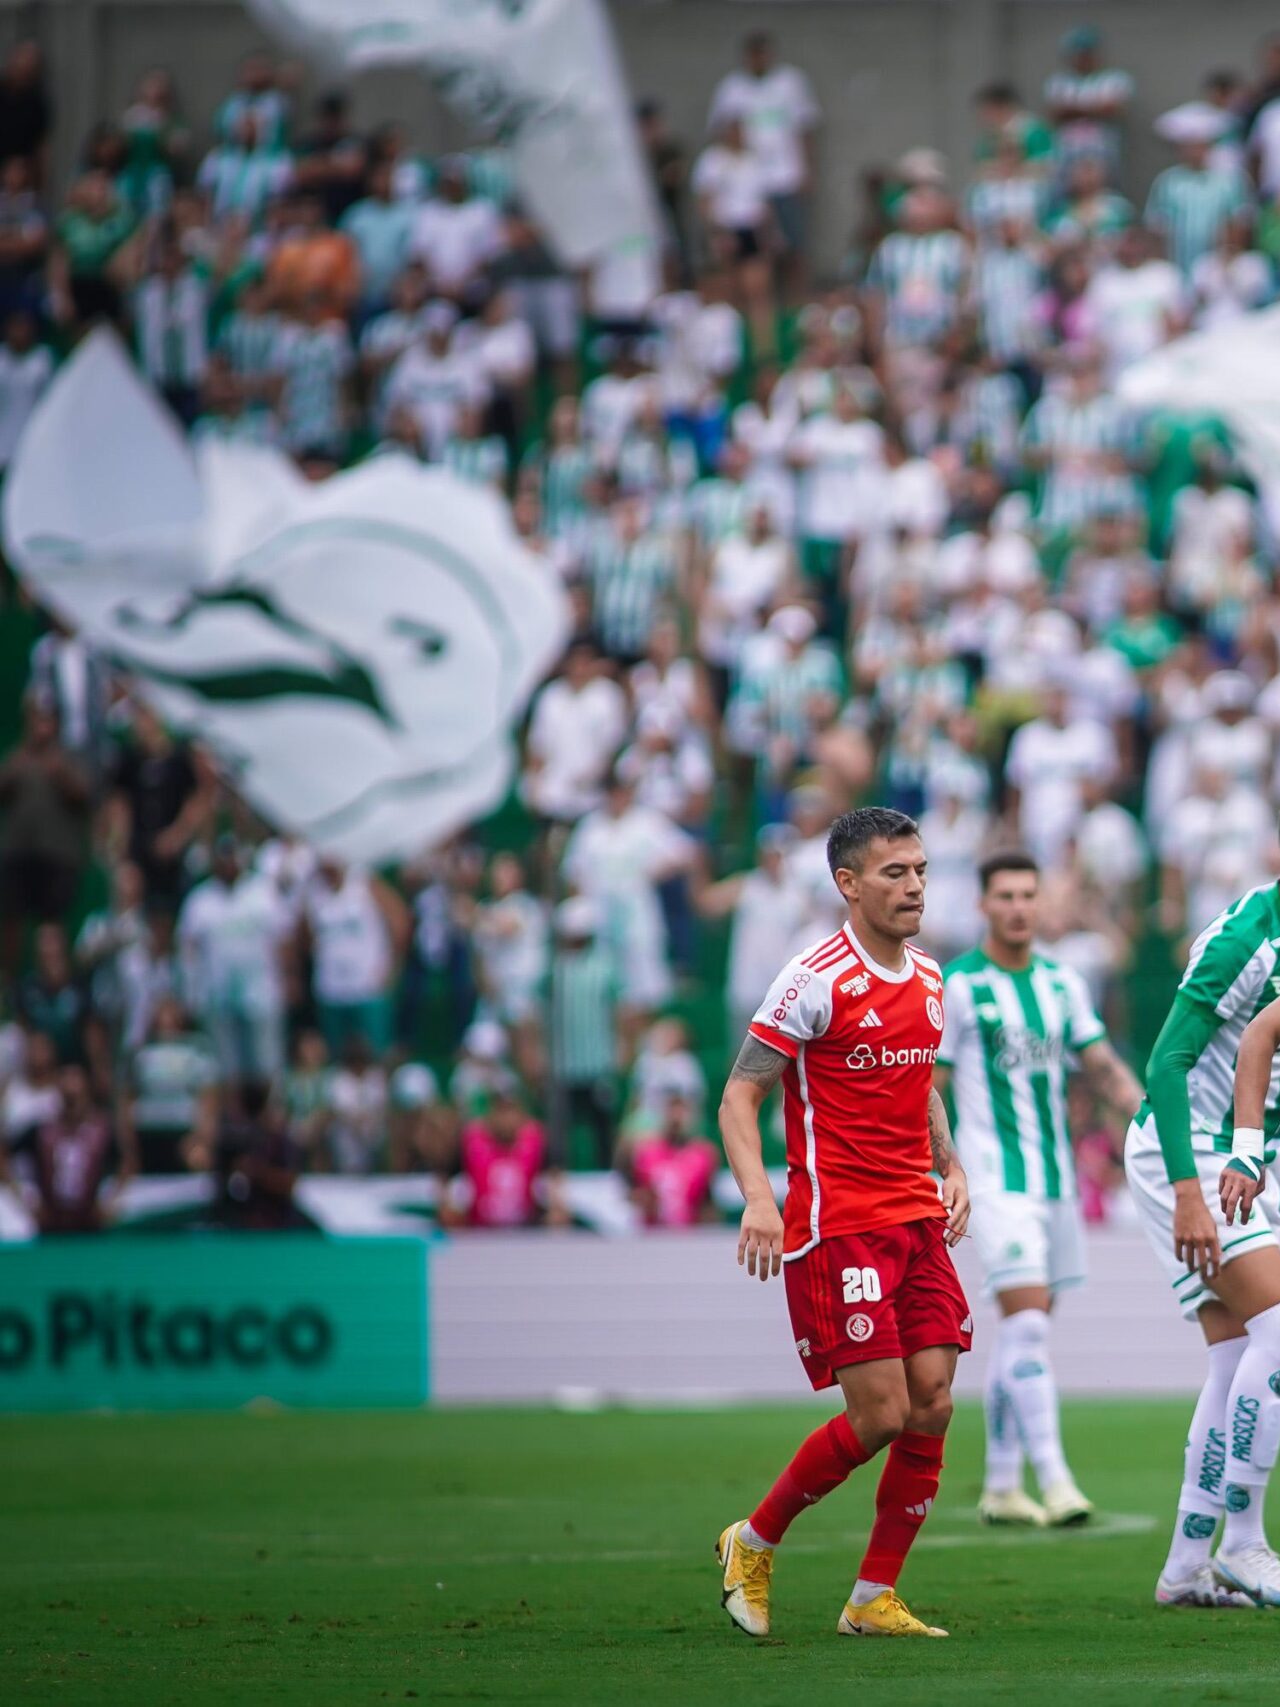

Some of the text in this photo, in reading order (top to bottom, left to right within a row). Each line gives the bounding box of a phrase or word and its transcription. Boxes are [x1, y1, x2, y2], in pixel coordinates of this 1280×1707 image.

[768, 987, 798, 1031] vero
[841, 1266, 882, 1304] 20
[47, 1291, 334, 1371] Pitaco
[1231, 1395, 1260, 1463] PROSOCKS
